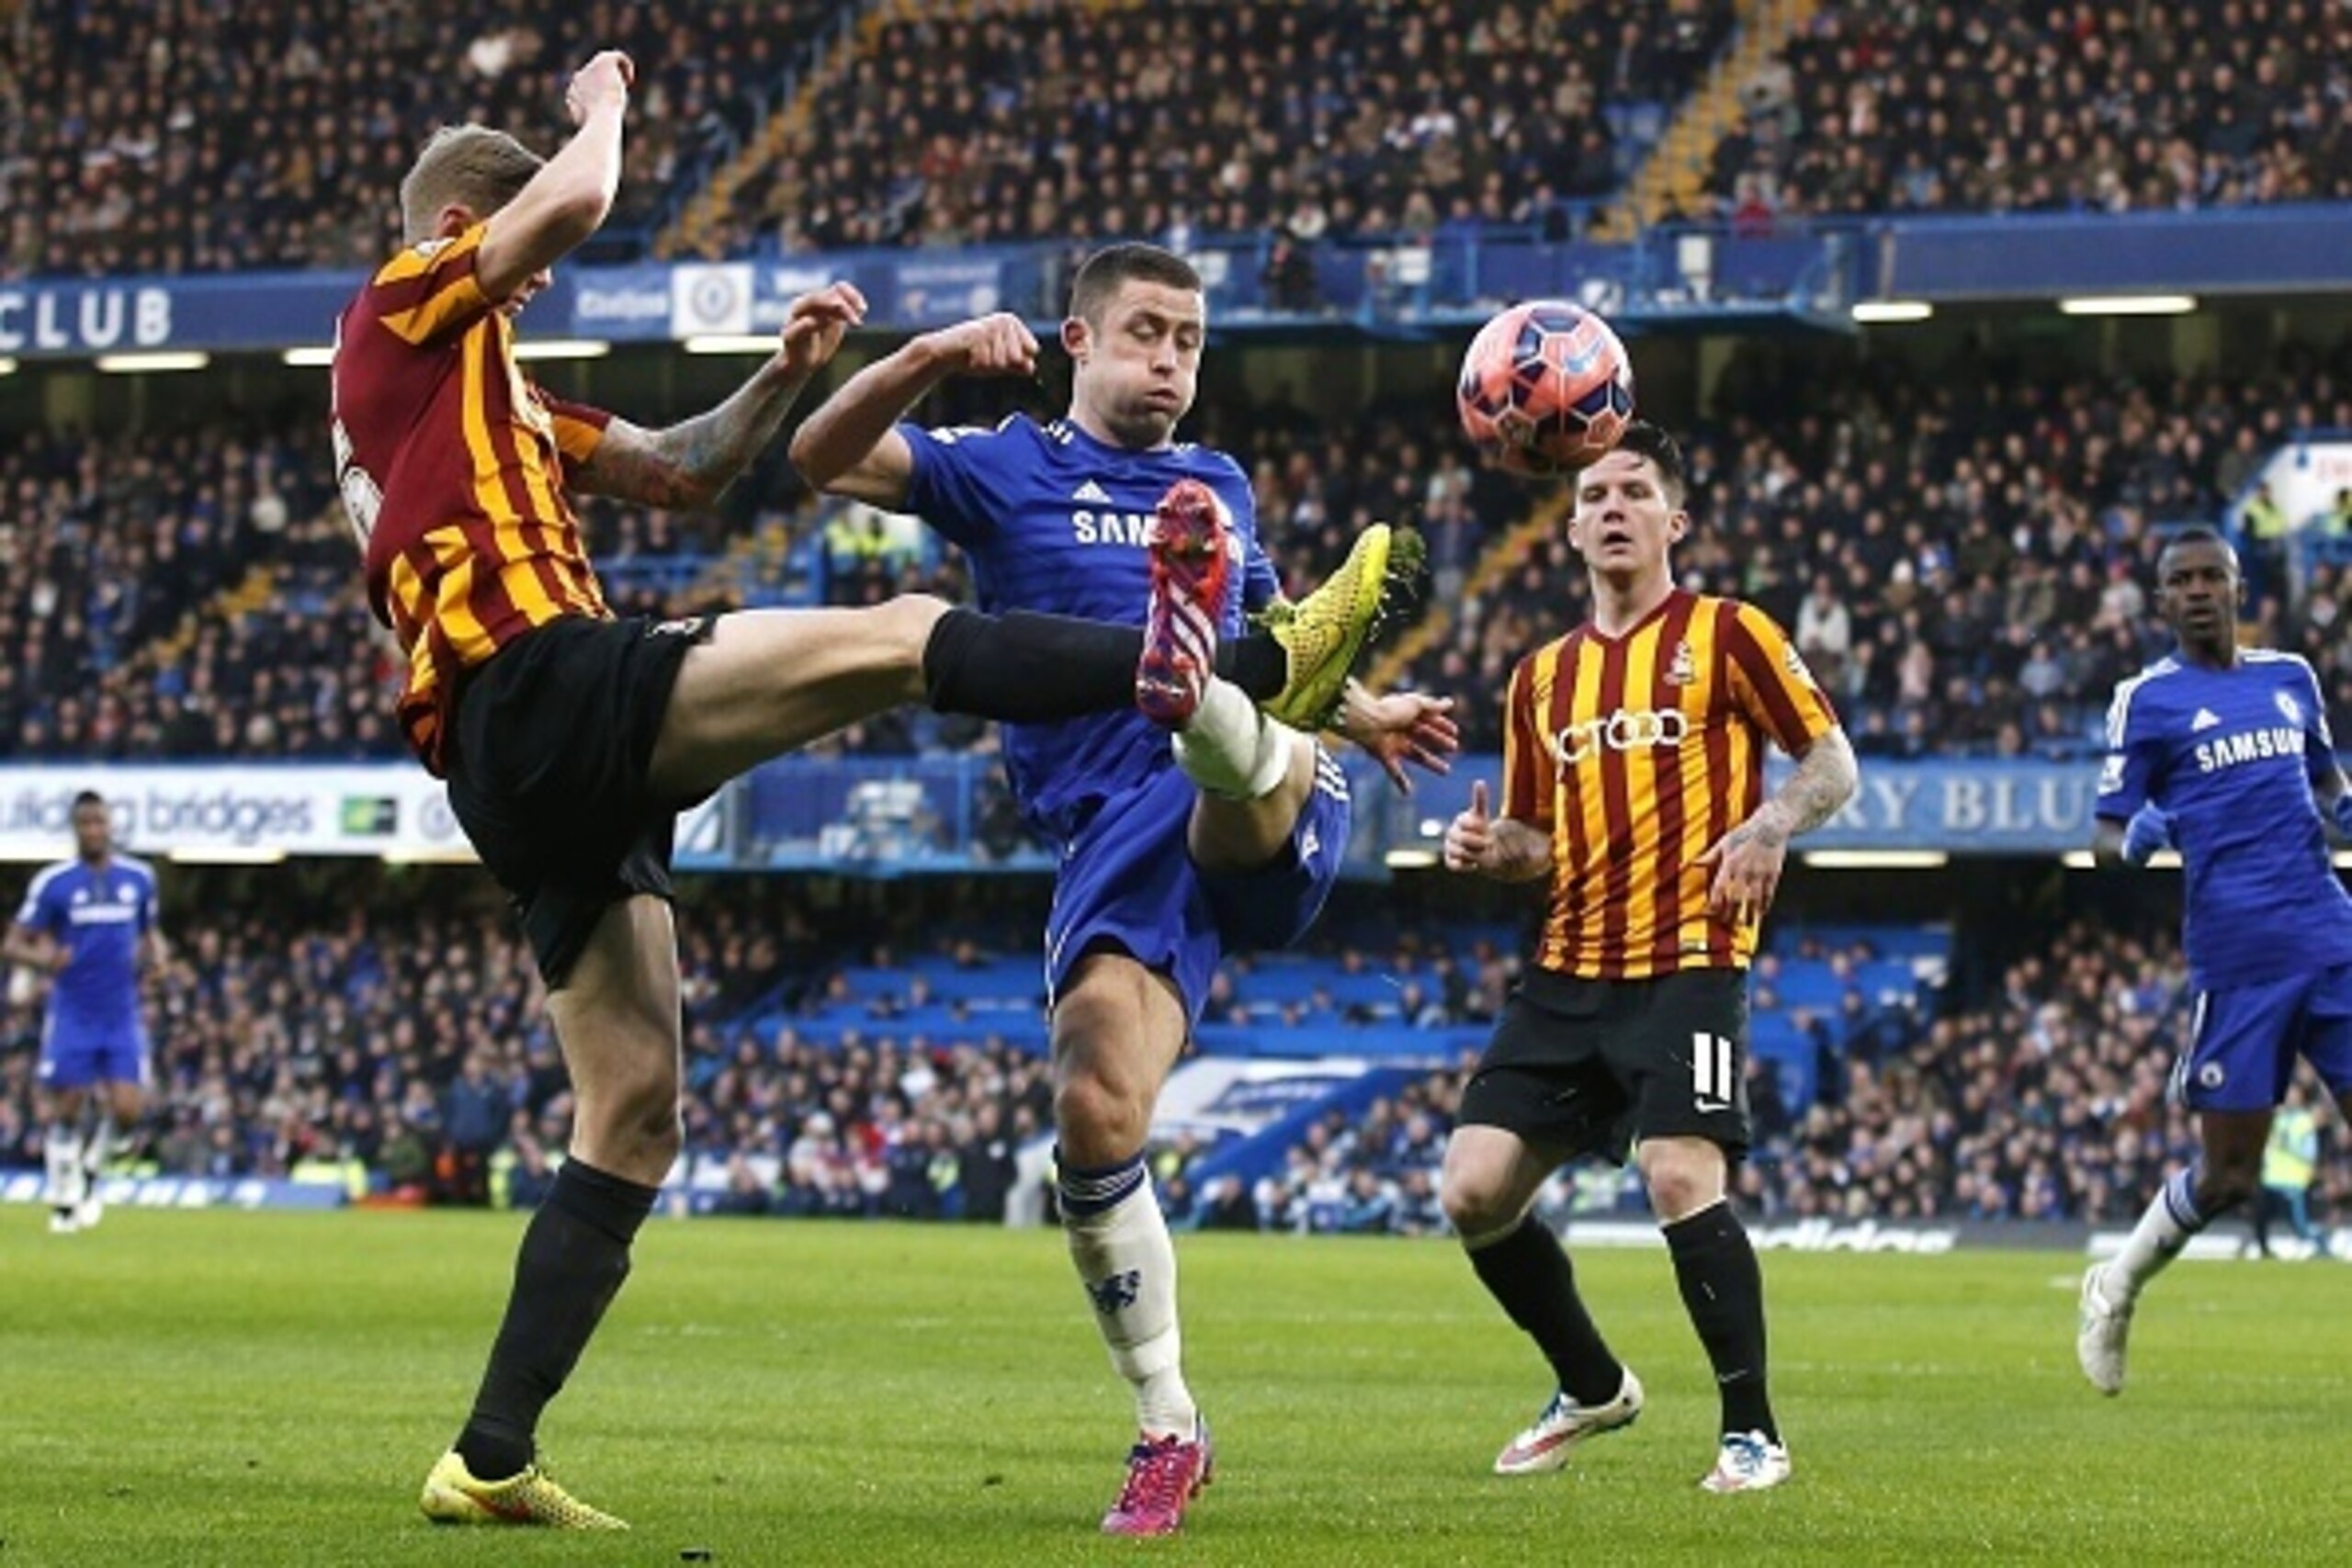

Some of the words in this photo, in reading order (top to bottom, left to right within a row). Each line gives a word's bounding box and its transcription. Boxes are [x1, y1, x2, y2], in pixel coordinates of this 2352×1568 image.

[0, 288, 171, 351] CLUB
[148, 787, 312, 847] bridges
[1694, 1032, 1731, 1101] 11
